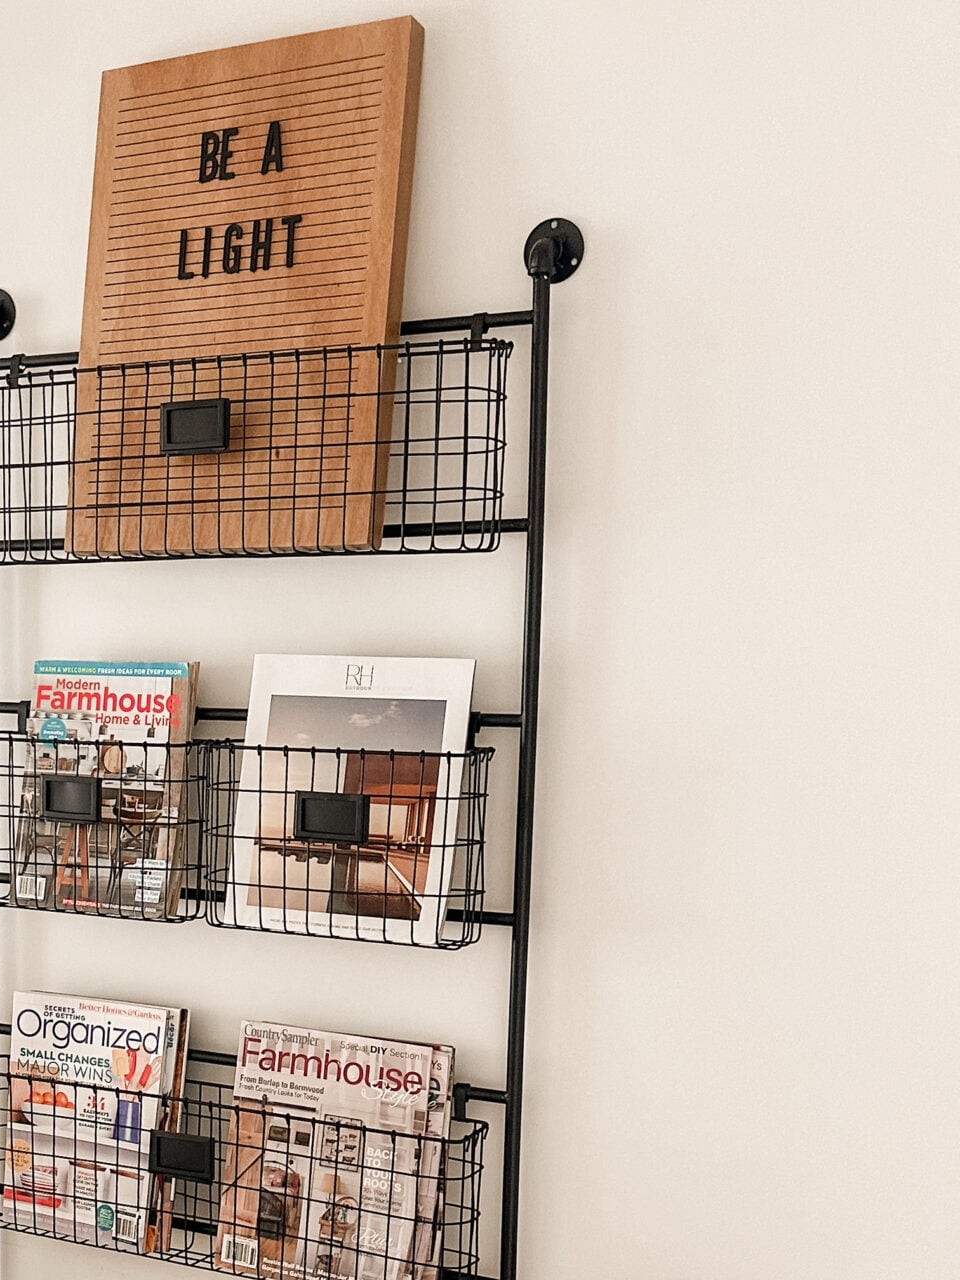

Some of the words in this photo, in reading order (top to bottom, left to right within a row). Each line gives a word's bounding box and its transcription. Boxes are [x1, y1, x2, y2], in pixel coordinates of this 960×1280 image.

[198, 127, 238, 183] BE
[261, 121, 284, 175] A
[177, 215, 302, 280] LIGHT
[345, 664, 375, 686] RH
[56, 679, 100, 690] Modern
[36, 685, 181, 714] Farmhouse
[96, 713, 130, 725] Home
[133, 715, 140, 725] &
[44, 1004, 76, 1014] SECRETS
[55, 1013, 86, 1021] GETTING
[79, 1003, 101, 1013] Better
[17, 1009, 161, 1055] Organized
[20, 1047, 56, 1061] SMALL
[340, 1041, 369, 1054] Special
[370, 1045, 387, 1055] DIY
[390, 1048, 423, 1060] Section!
[17, 1058, 70, 1076] MAJOR
[73, 1064, 113, 1083] WINS
[242, 1037, 422, 1095] Farmhouse
[240, 1074, 257, 1084] From
[258, 1077, 280, 1089] Burlap
[289, 1082, 325, 1095] Barnwood
[256, 1085, 276, 1096] Country
[303, 1093, 320, 1102] Today
[361, 1079, 419, 1107] Style
[365, 1158, 381, 1167] TO
[366, 1147, 398, 1161] BACK
[365, 1168, 396, 1181] YOUR
